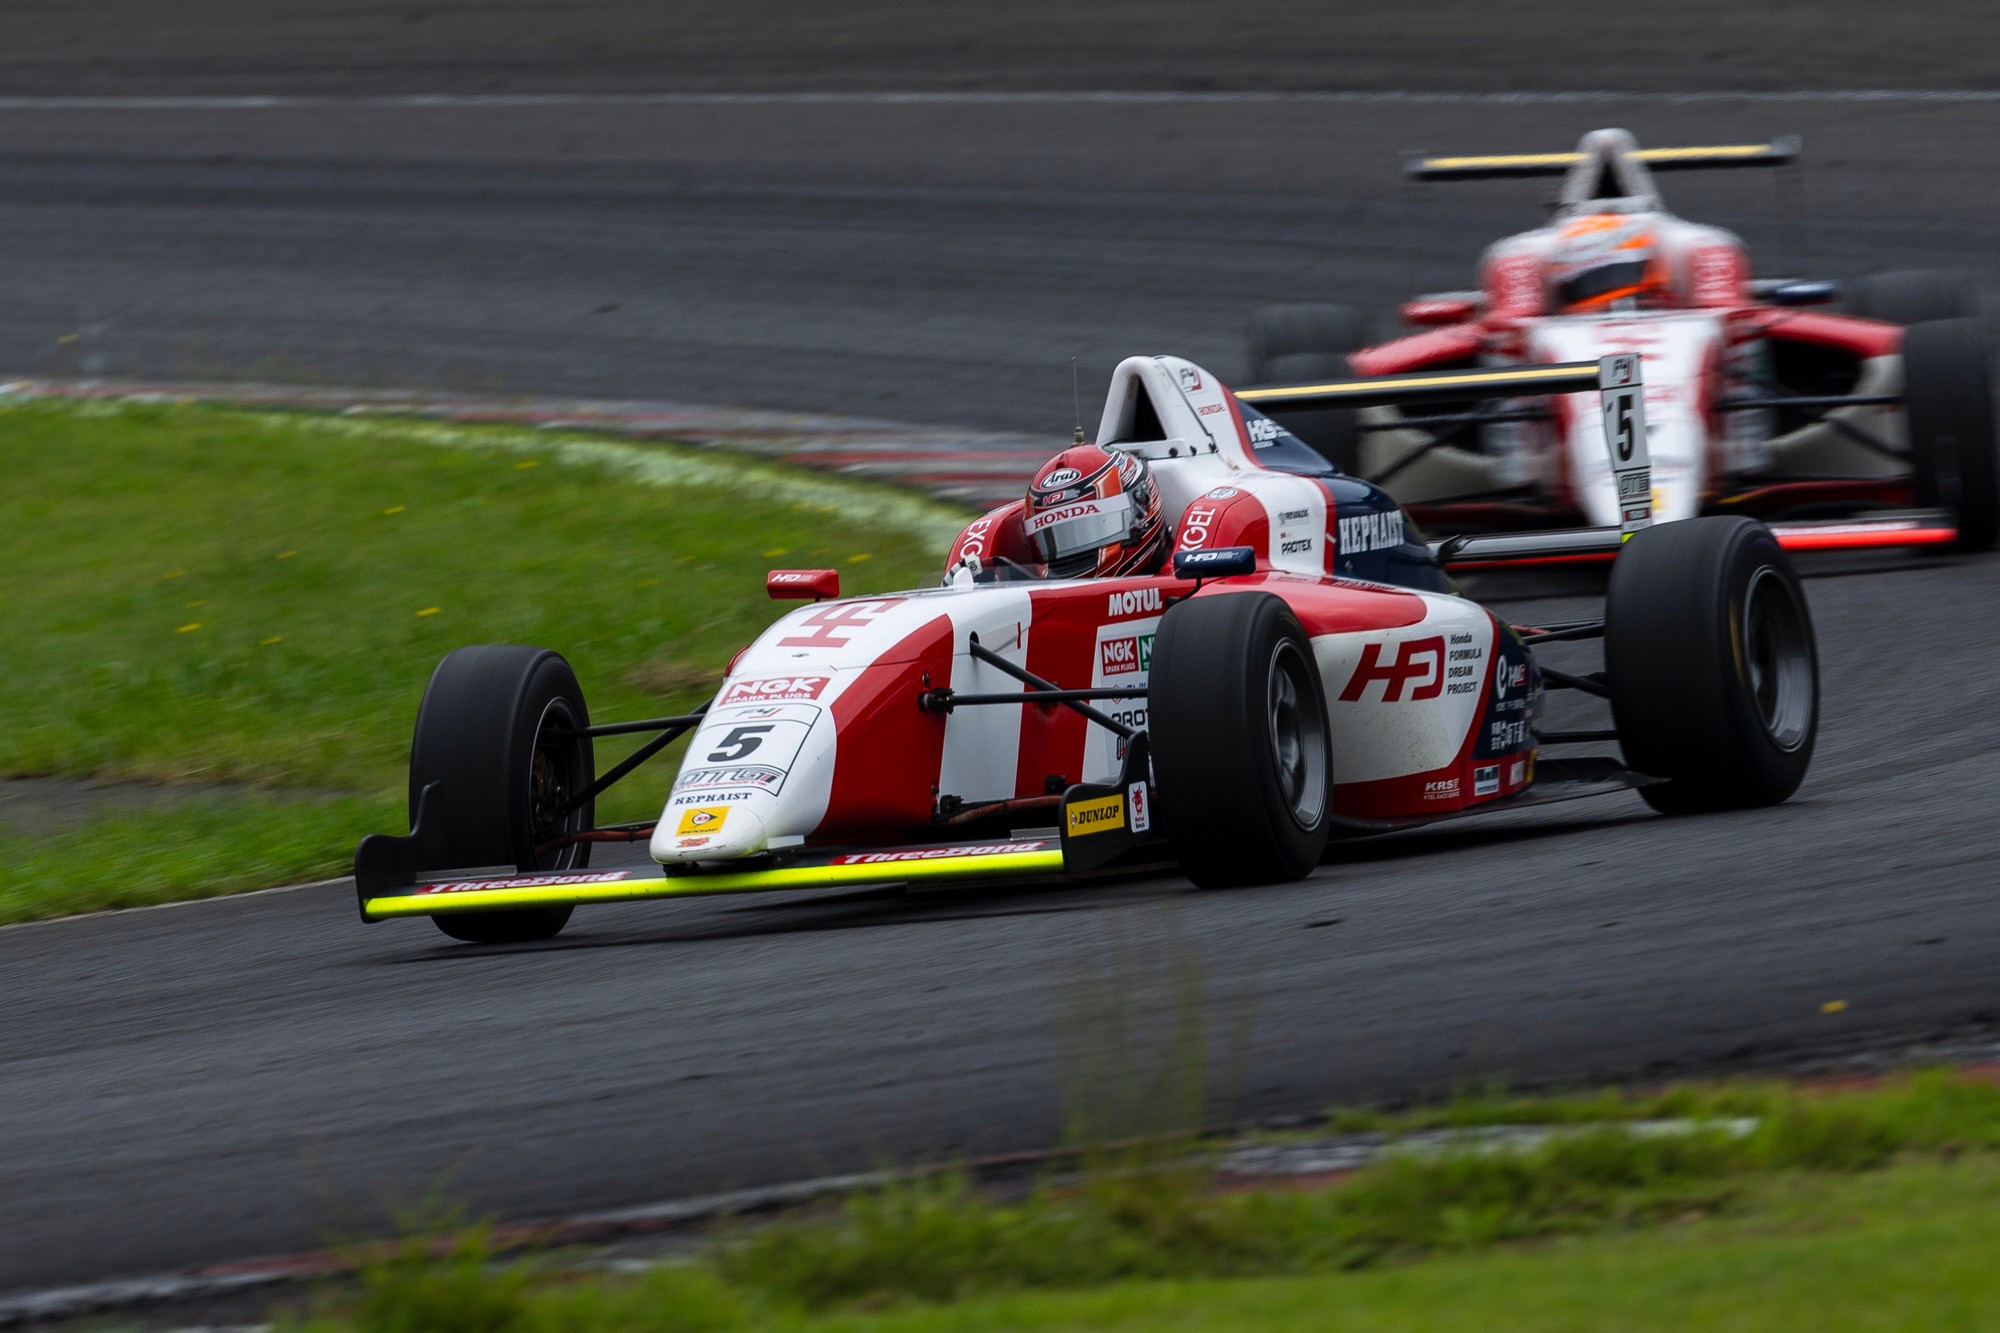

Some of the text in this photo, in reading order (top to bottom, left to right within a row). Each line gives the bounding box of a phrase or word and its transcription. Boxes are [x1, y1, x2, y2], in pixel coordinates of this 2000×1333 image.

[1617, 394, 1634, 462] 5
[1033, 504, 1100, 530] HONDA
[1108, 587, 1163, 617] MOTUL
[1450, 632, 1473, 646] Honda
[1103, 639, 1135, 664] NGK
[1449, 647, 1483, 662] FORMULA
[1448, 664, 1474, 678] DREAM
[726, 692, 811, 704] SPARK PLUGS
[729, 677, 821, 698] NGK
[1447, 681, 1478, 695] PROJECT
[707, 724, 776, 762] 5
[1078, 805, 1119, 824] DUNLOP
[843, 841, 1044, 864] ThreeBond
[429, 870, 630, 893] ThreeBond
